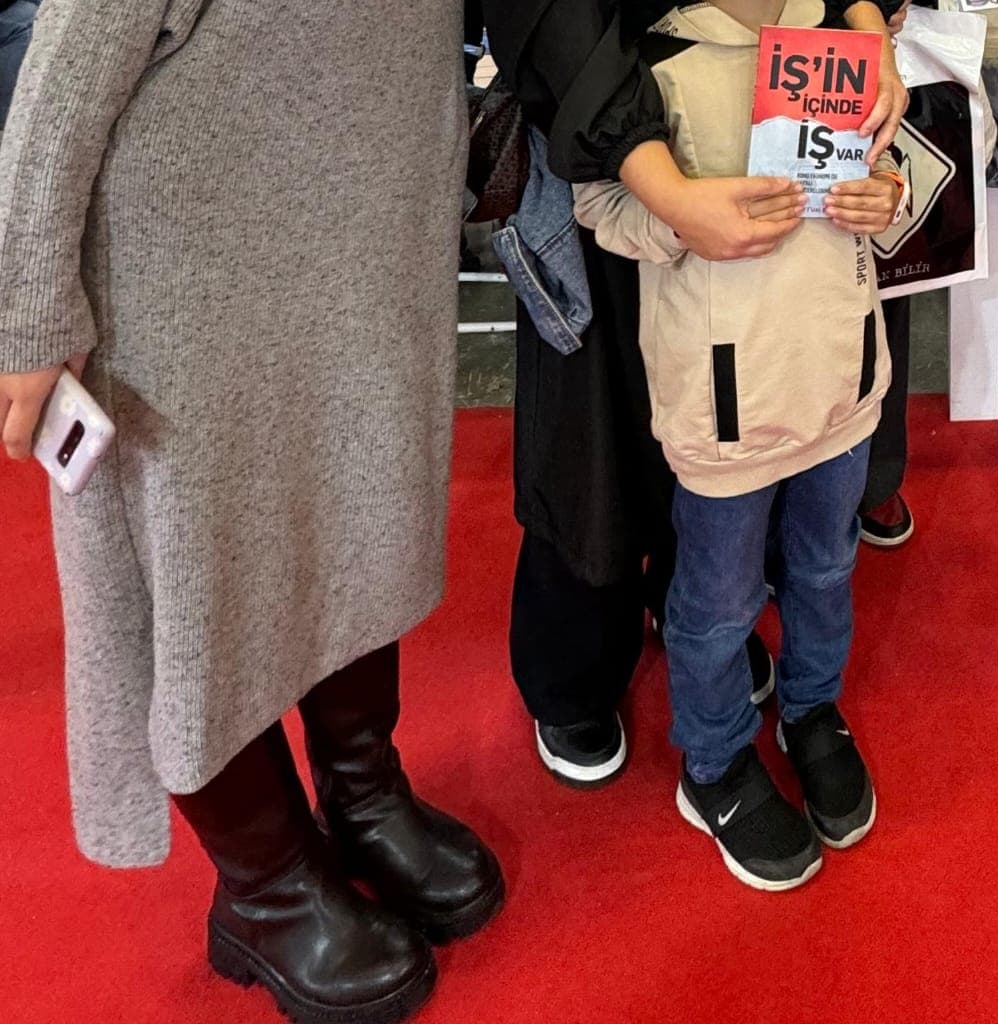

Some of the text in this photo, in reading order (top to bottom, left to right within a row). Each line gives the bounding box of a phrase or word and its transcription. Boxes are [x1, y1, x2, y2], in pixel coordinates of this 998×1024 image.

[802, 93, 863, 117] İÇİNDE
[796, 119, 863, 170] İŞ VAR
[856, 250, 868, 287] SPORT
